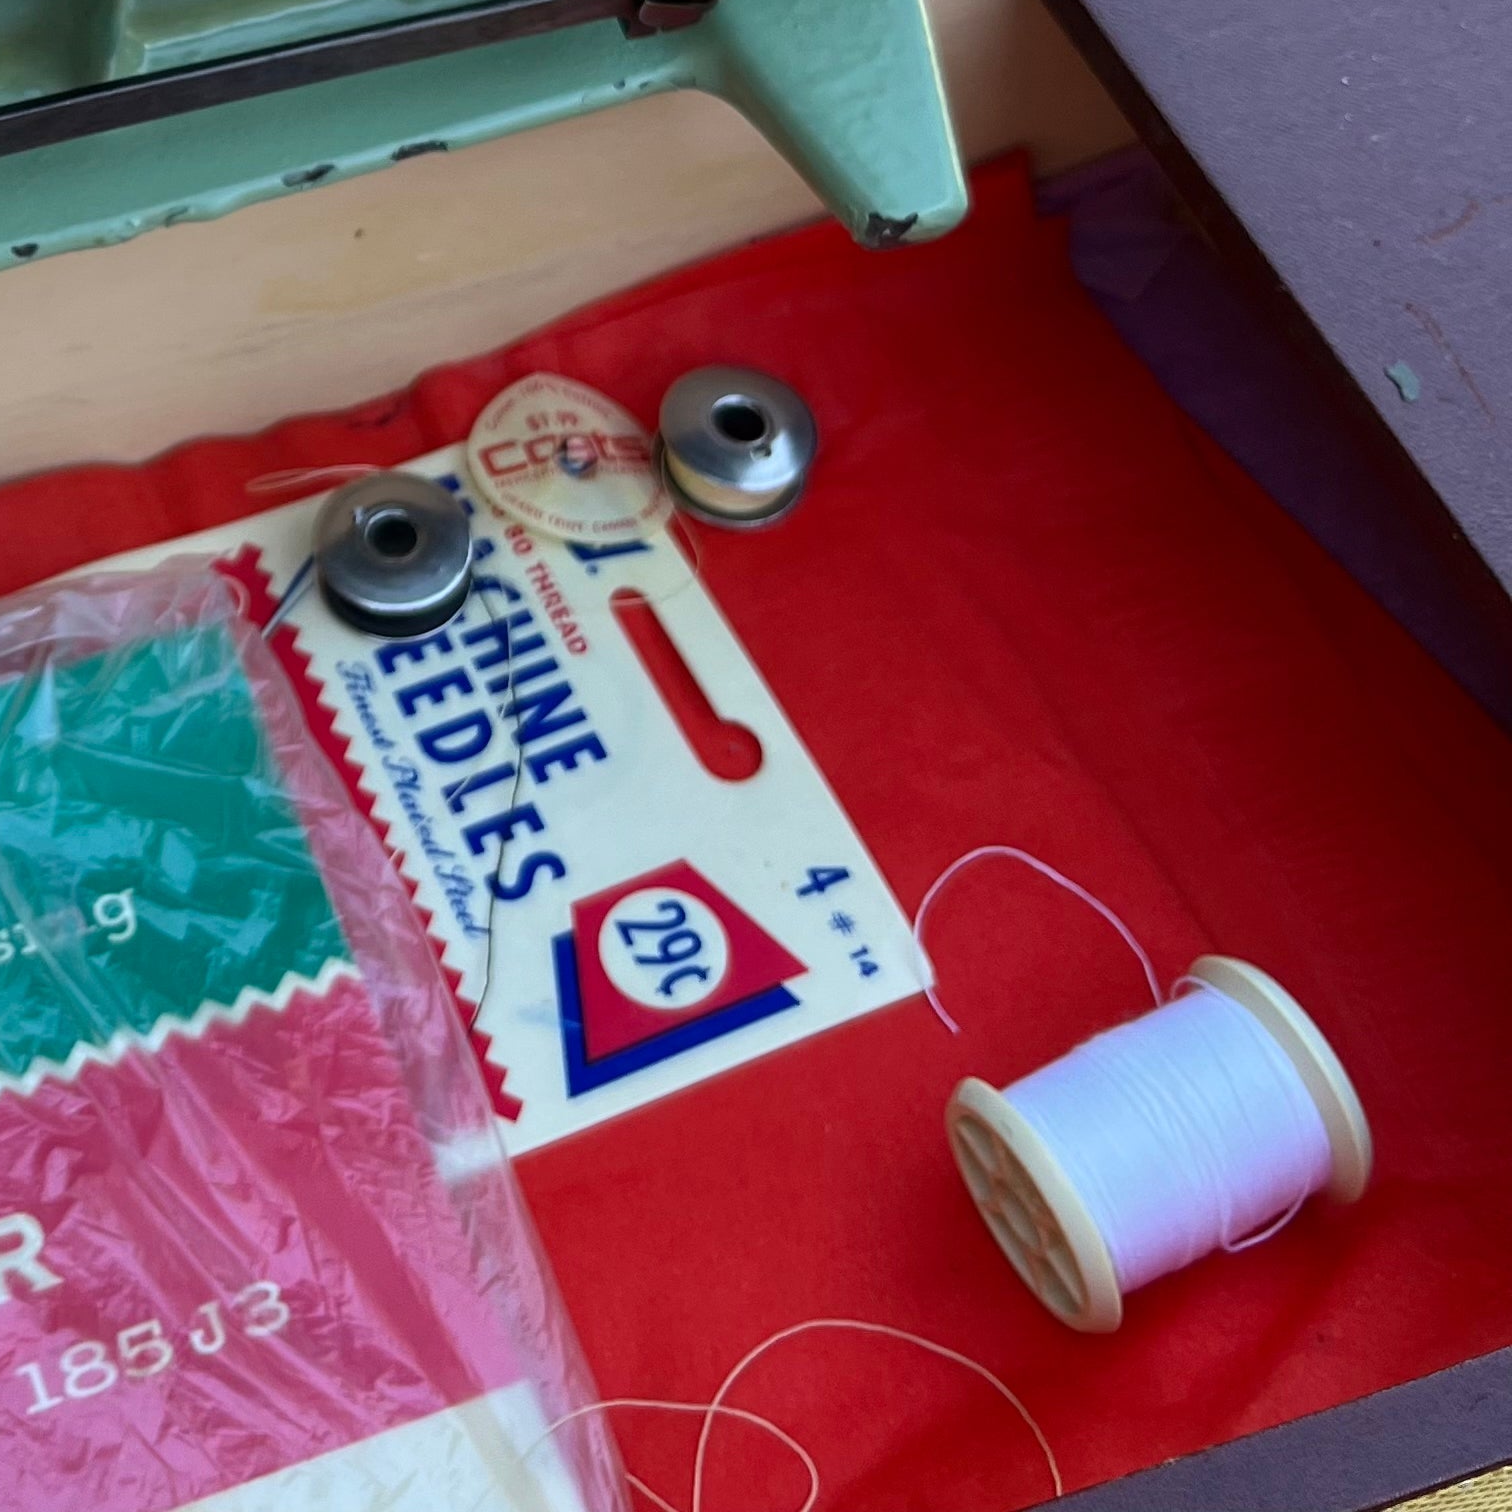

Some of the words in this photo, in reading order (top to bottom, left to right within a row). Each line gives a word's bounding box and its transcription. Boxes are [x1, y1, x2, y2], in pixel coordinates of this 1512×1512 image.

[440, 473, 607, 785] CHINE
[526, 561, 588, 656] THREAD
[336, 661, 395, 750] Finest
[382, 756, 455, 860] Plated
[434, 865, 491, 938] Steel
[374, 628, 566, 901] EEDLES
[795, 865, 851, 899] 4
[850, 944, 880, 978] 14
[17, 1281, 291, 1416] 185J3
